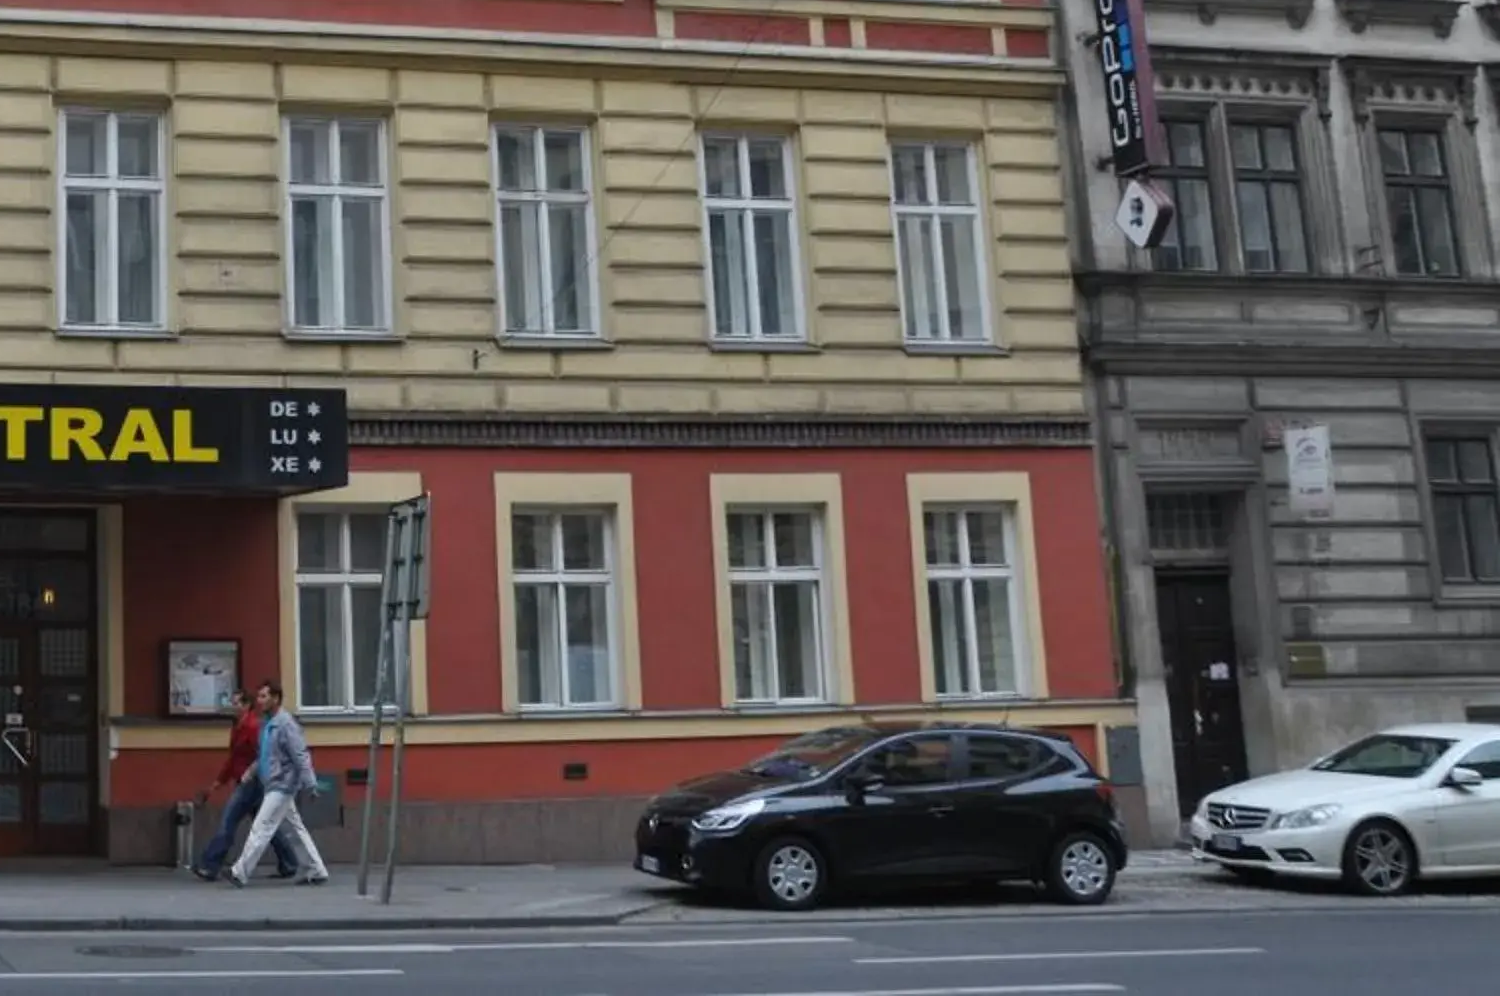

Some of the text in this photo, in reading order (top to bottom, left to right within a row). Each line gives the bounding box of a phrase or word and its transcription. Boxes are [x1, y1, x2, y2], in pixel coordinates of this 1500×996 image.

[270, 401, 299, 417] DE
[270, 429, 297, 445] LU
[270, 457, 299, 473] XE
